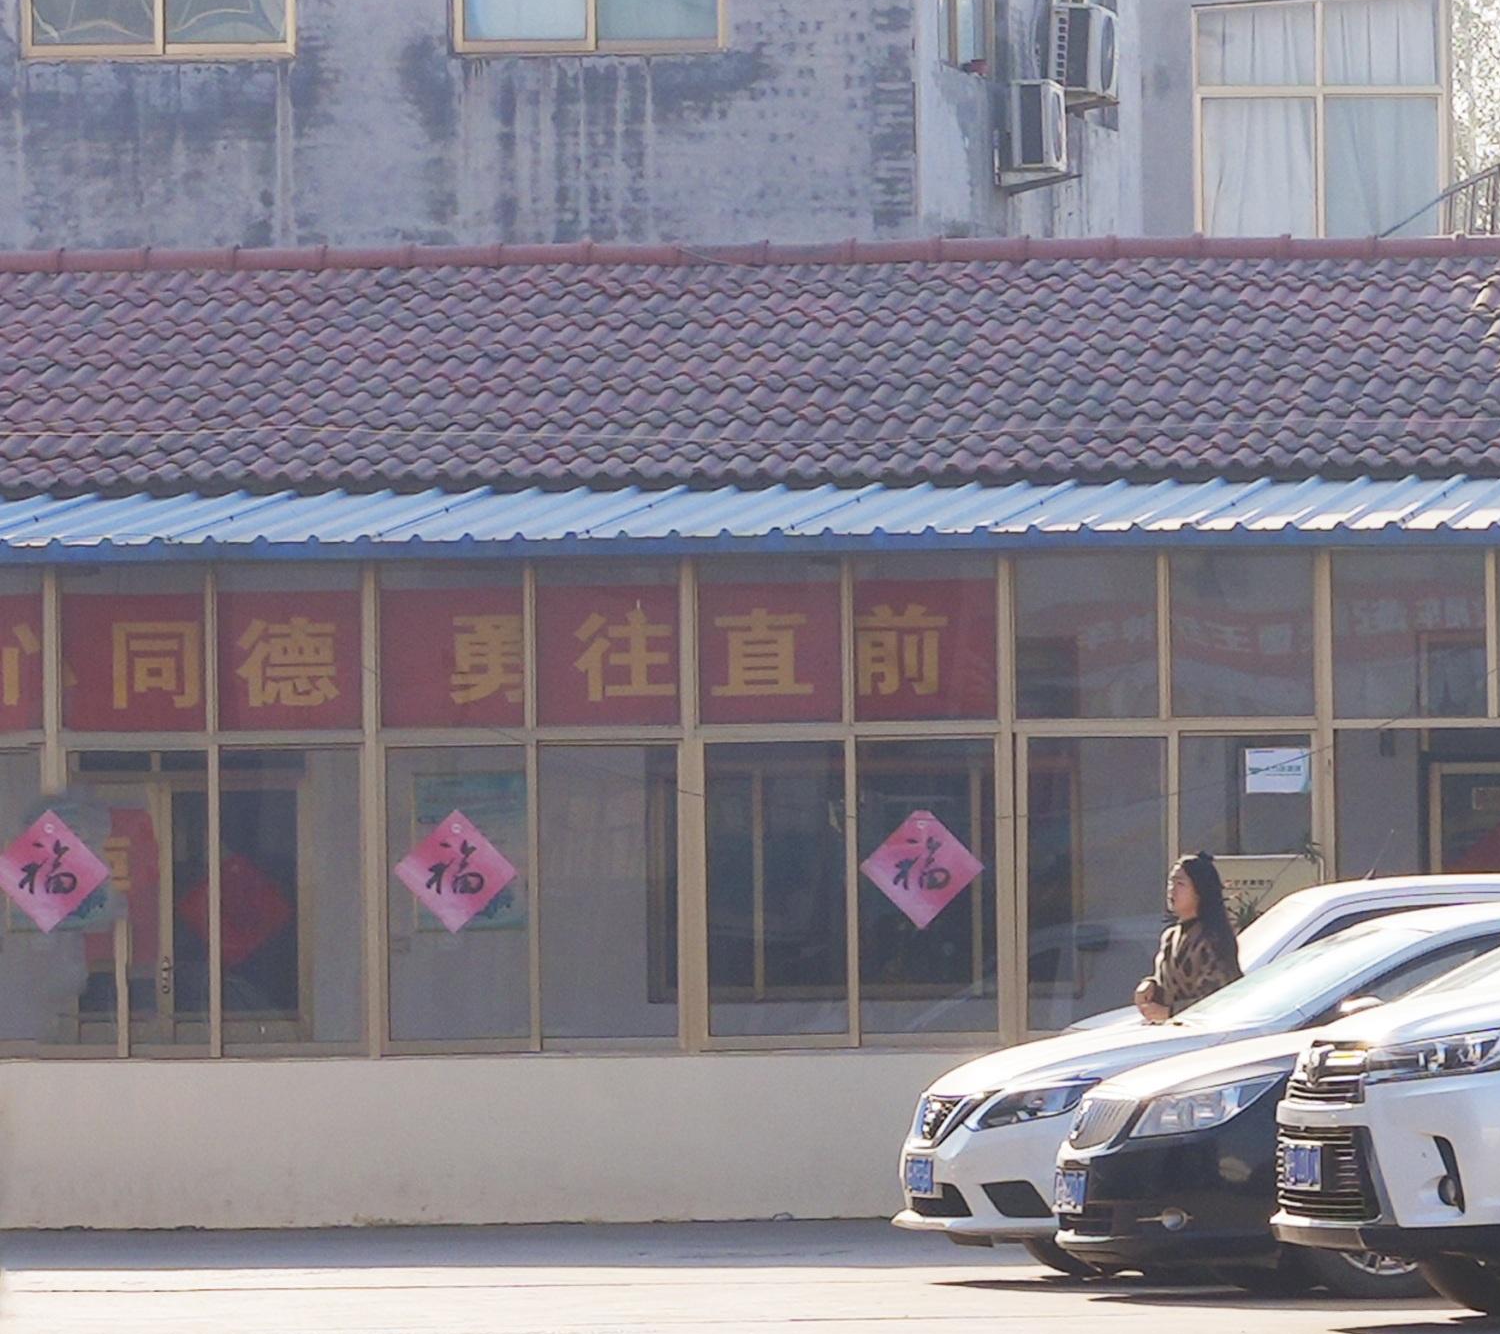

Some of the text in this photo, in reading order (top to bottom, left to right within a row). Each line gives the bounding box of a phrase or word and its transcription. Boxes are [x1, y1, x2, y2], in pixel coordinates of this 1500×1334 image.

[449, 603, 949, 705] 勇往直前
[18, 839, 78, 895] 福
[425, 839, 485, 895] 福
[892, 835, 951, 891] 福
